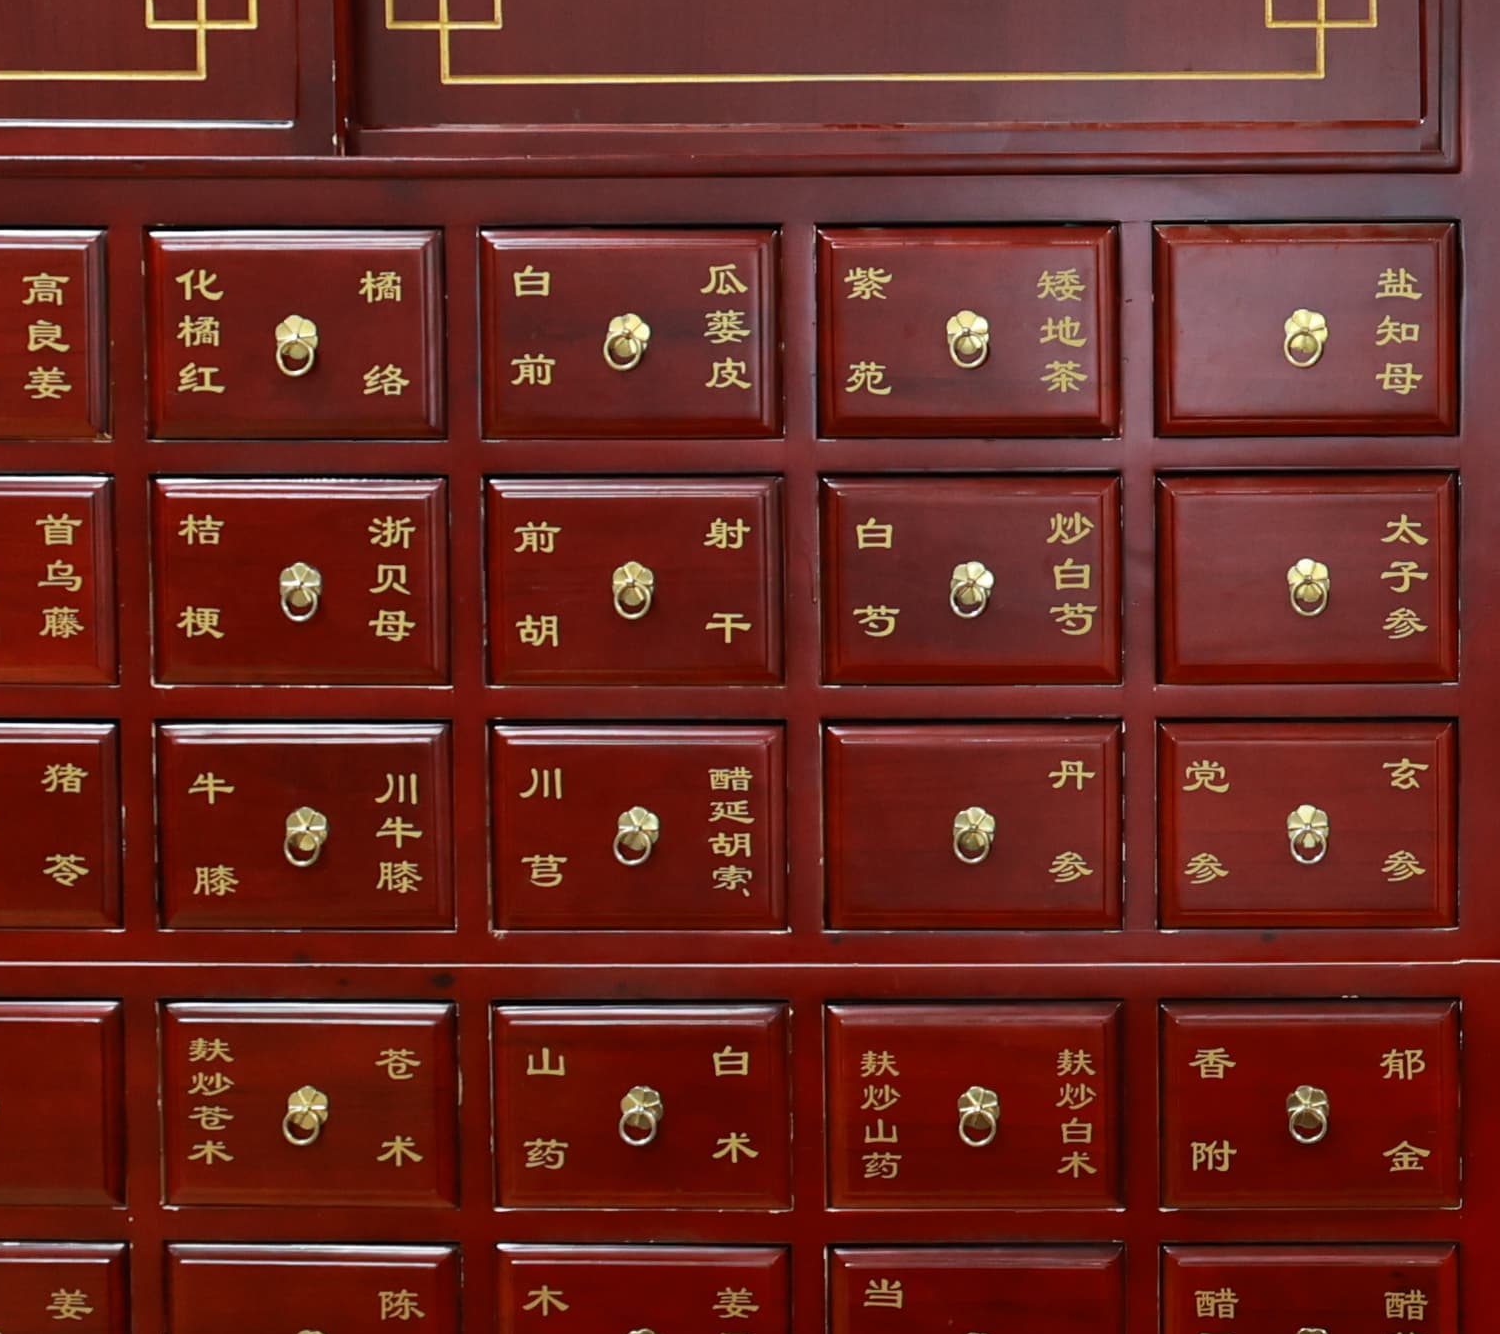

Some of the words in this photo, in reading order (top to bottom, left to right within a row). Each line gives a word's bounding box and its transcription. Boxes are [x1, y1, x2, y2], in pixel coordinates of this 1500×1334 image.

[20, 271, 74, 401] 高良姜
[174, 267, 227, 395] 化橘红
[699, 262, 753, 391] 瓜蒌皮
[1037, 269, 1089, 392] 矮地茶
[1374, 267, 1426, 397] 盐知母
[34, 512, 86, 640] 首乌藤
[366, 514, 418, 643] 浙贝母
[1045, 510, 1099, 637] 炒白芍
[1379, 513, 1430, 639] 太子参
[373, 772, 424, 894] 川牛膝
[707, 765, 757, 899] 醋延胡索
[186, 1036, 236, 1166] 麸炒苍术
[860, 1049, 902, 1180] 麸炒山药
[1057, 1048, 1098, 1178] 麸炒白术
